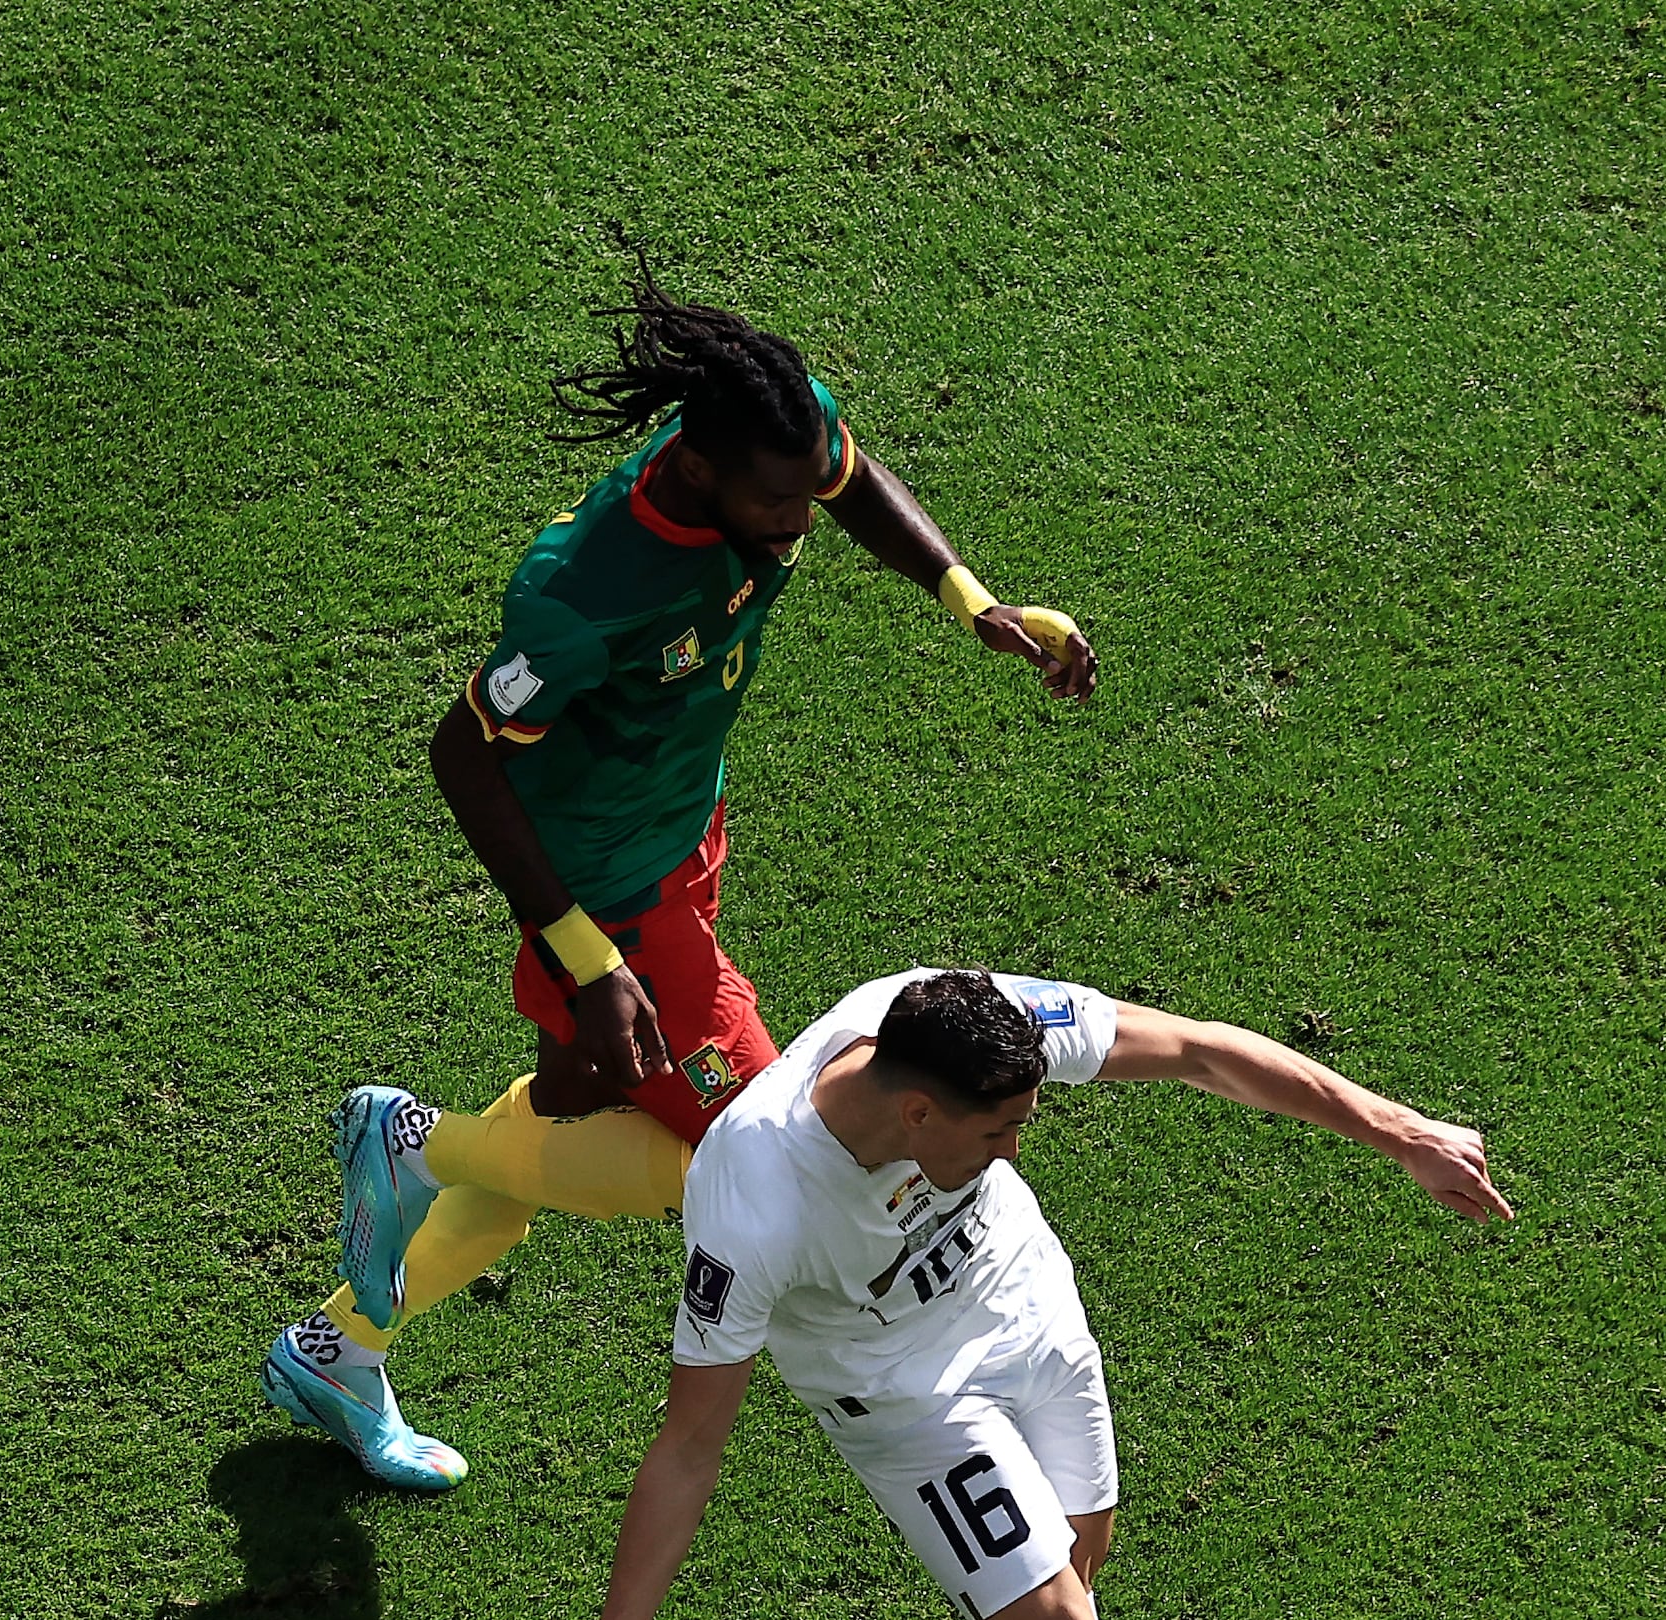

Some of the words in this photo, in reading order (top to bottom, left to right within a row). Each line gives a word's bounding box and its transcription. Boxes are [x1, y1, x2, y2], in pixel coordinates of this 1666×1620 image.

[728, 579, 754, 615] one
[897, 1196, 932, 1233] PUMA
[917, 1454, 1031, 1575] 16
